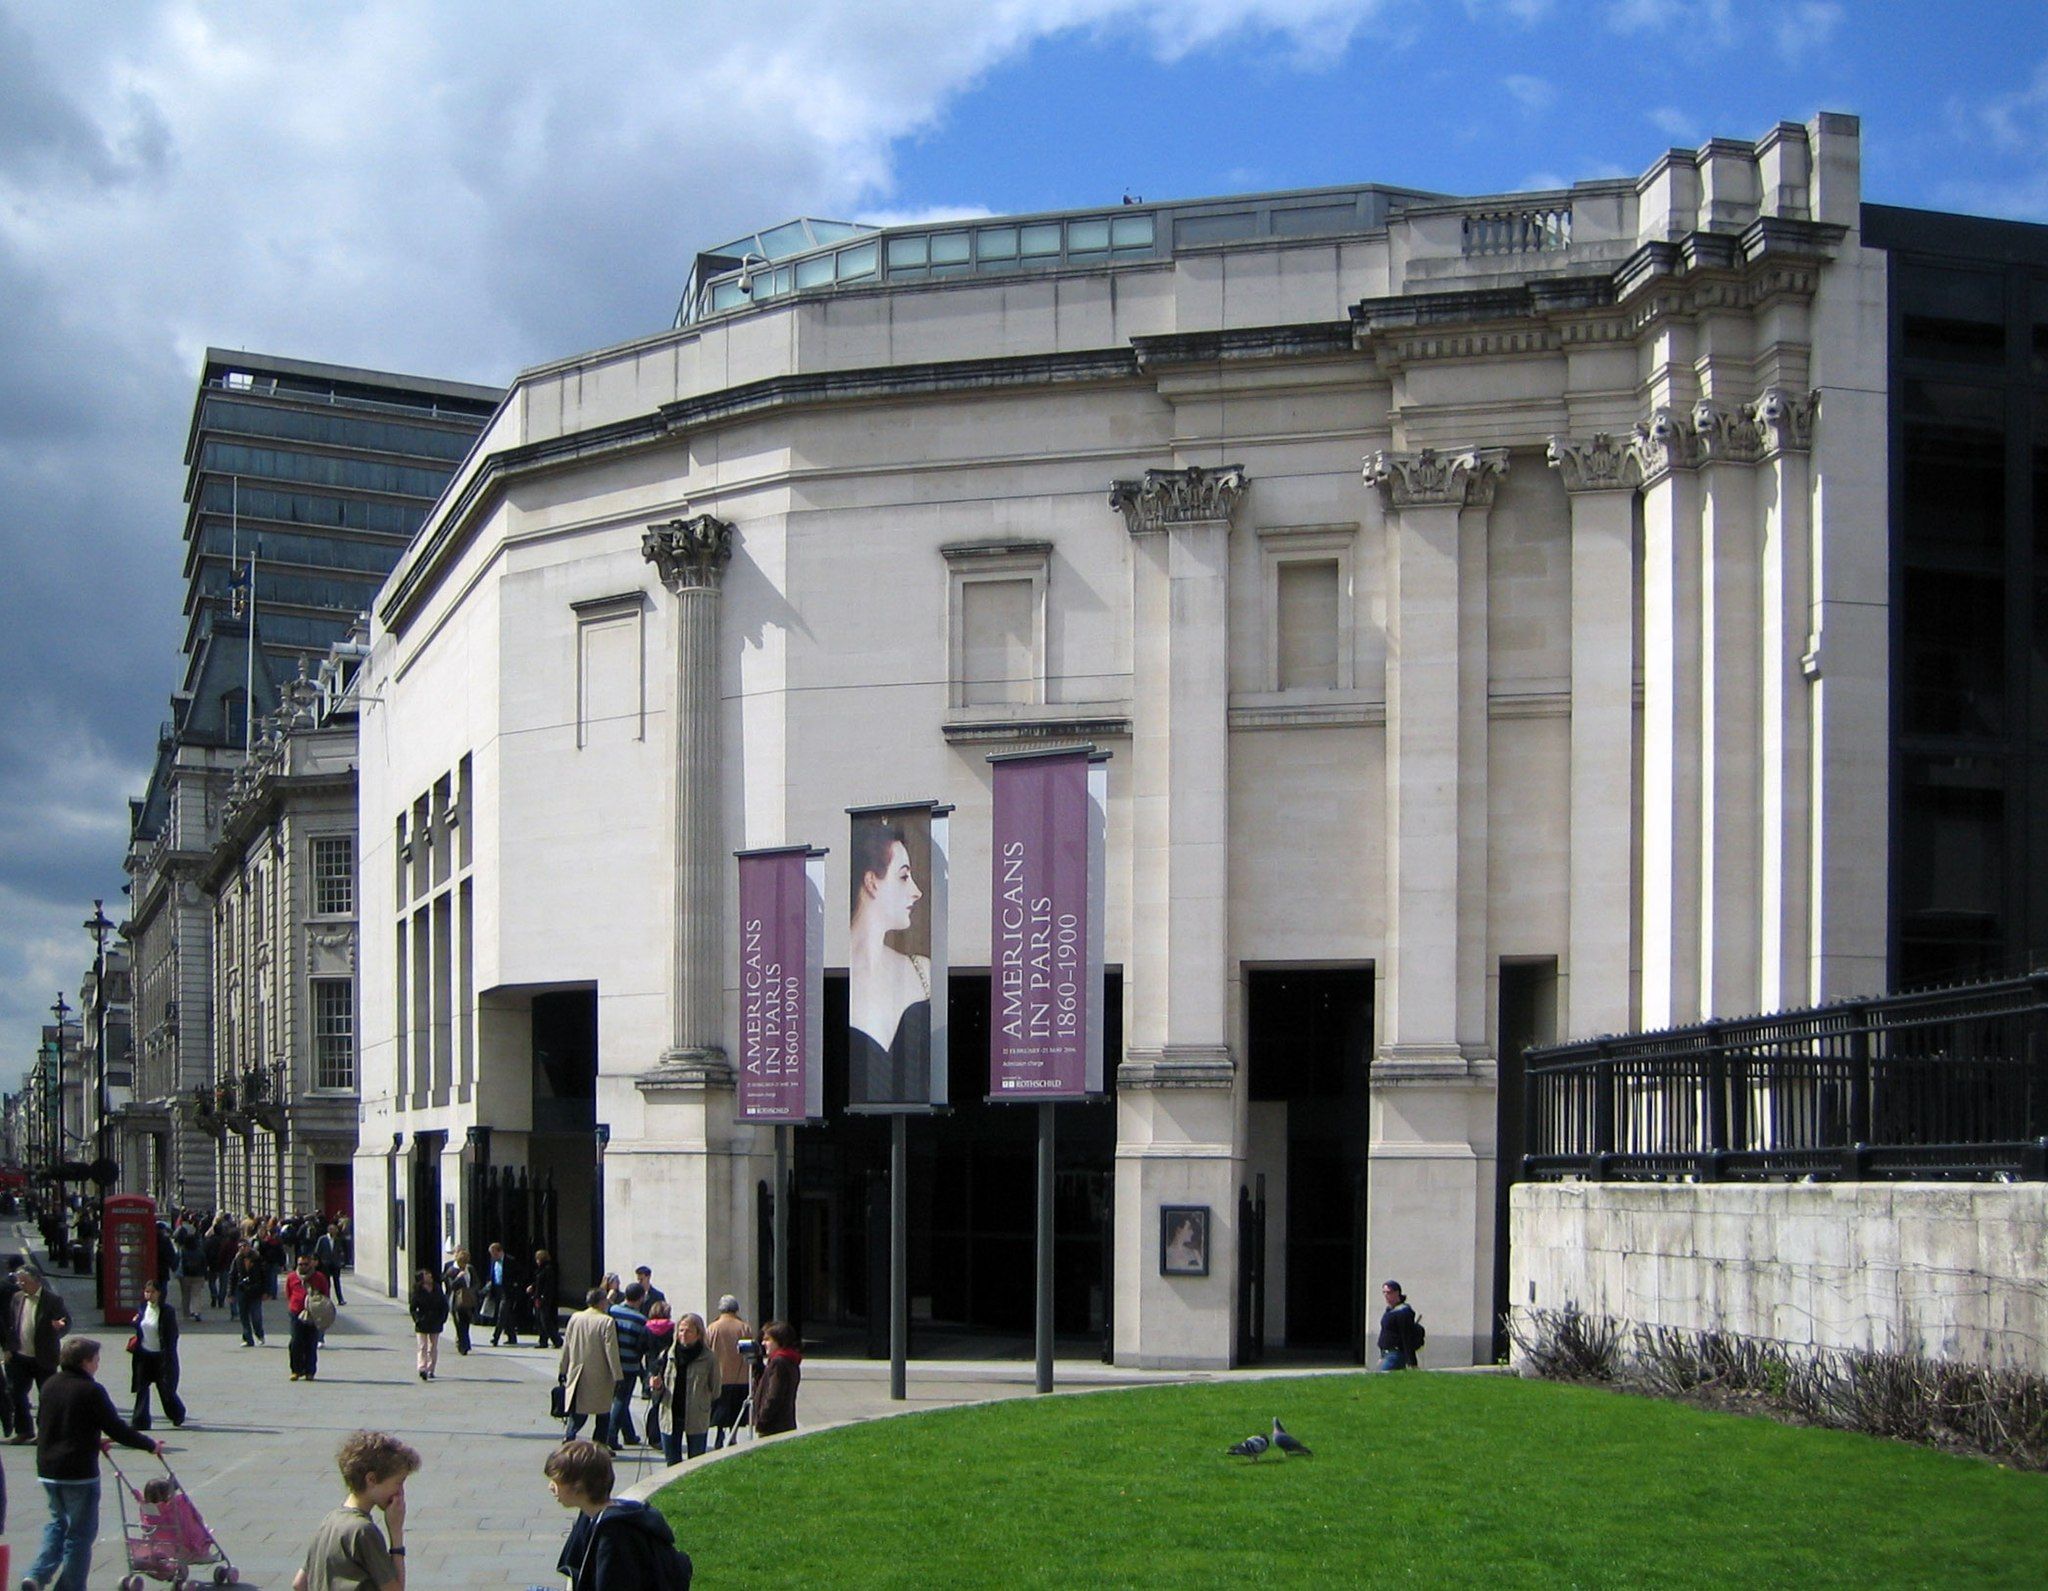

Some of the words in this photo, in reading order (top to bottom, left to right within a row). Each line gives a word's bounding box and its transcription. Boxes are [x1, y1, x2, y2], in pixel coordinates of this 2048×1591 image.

[1002, 842, 1024, 1039] AMERICANS
[1030, 897, 1051, 990] PARIS
[746, 919, 762, 1075] AMERICANS
[766, 963, 781, 1036] PARIS
[1030, 1002, 1050, 1038] IN
[766, 1047, 781, 1075] IN
